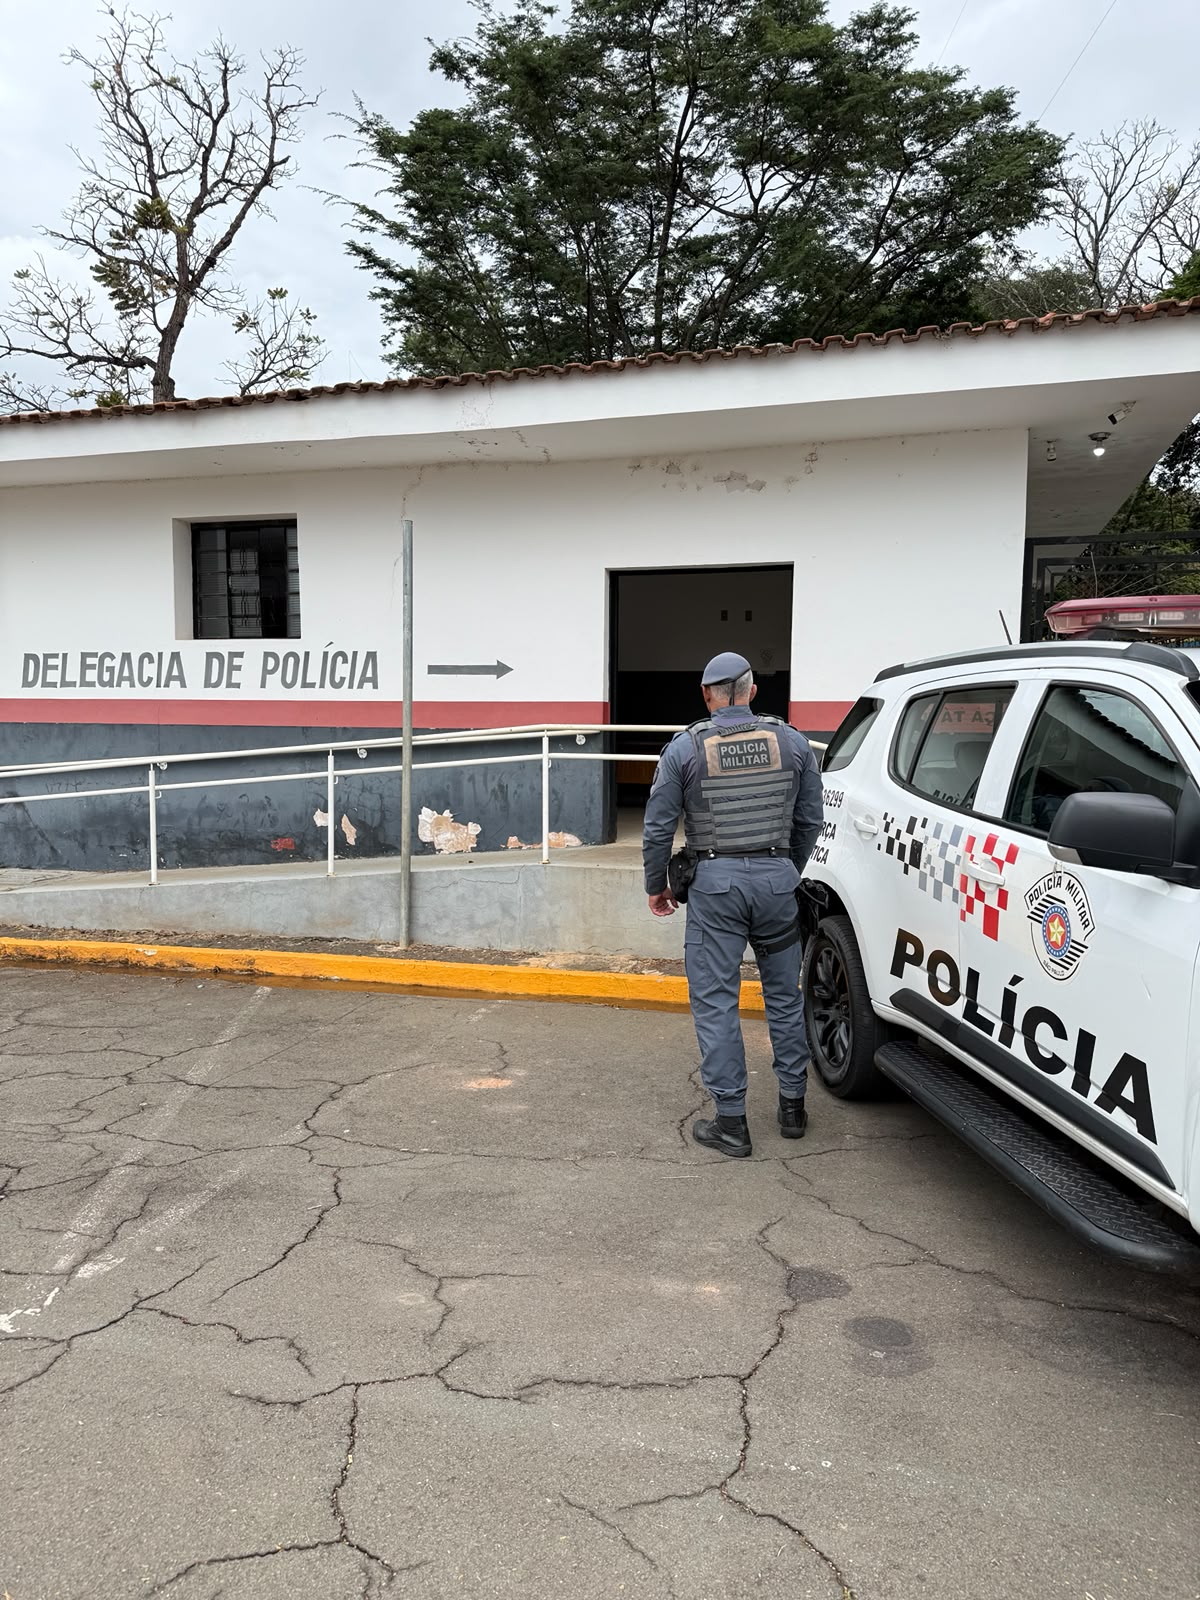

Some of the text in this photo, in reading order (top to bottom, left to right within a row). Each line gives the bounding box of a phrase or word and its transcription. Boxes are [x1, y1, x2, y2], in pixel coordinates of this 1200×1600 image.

[21, 641, 379, 690] DELEGACIA DE POLÍCIA
[720, 741, 767, 756] POLÍCIA
[721, 753, 769, 768] MILITAR
[819, 821, 837, 842] RÇA
[810, 845, 829, 865] TICA
[1065, 879, 1090, 930] MILITAR
[890, 928, 1157, 1145] POLÍCIA
